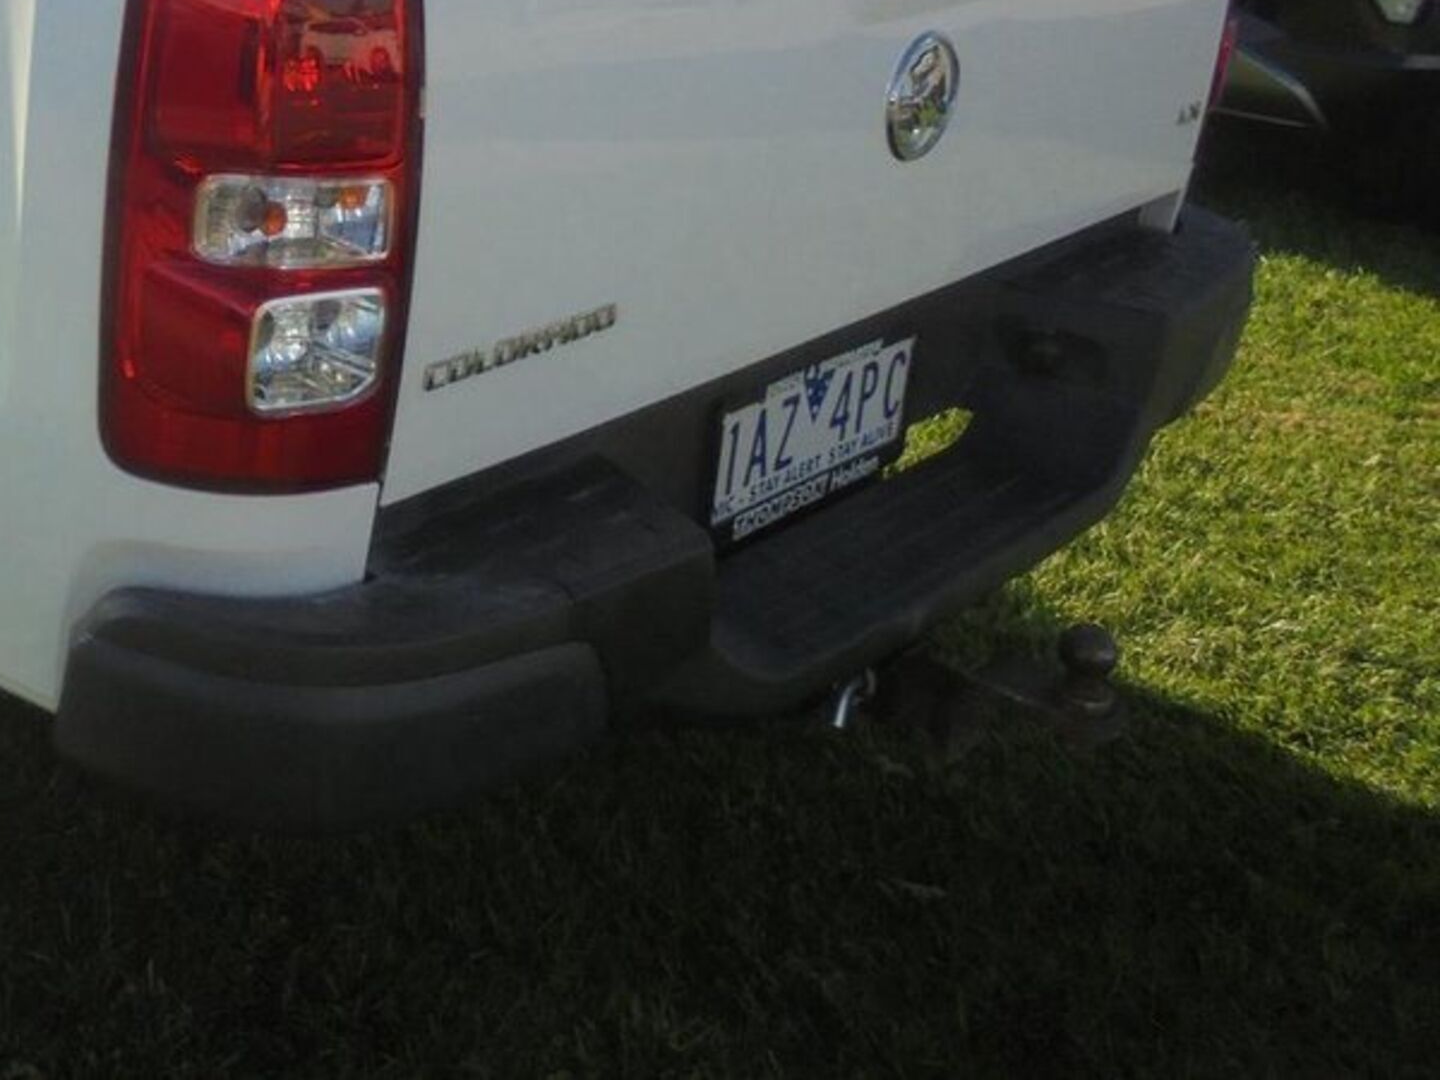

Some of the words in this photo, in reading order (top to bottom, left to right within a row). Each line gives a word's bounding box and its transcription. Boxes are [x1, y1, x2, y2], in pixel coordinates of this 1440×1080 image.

[422, 302, 617, 392] COLORADO
[723, 392, 802, 497] 1AZ
[828, 349, 907, 442] 4PC
[749, 470, 782, 505] STAY
[782, 452, 823, 487] ALERT
